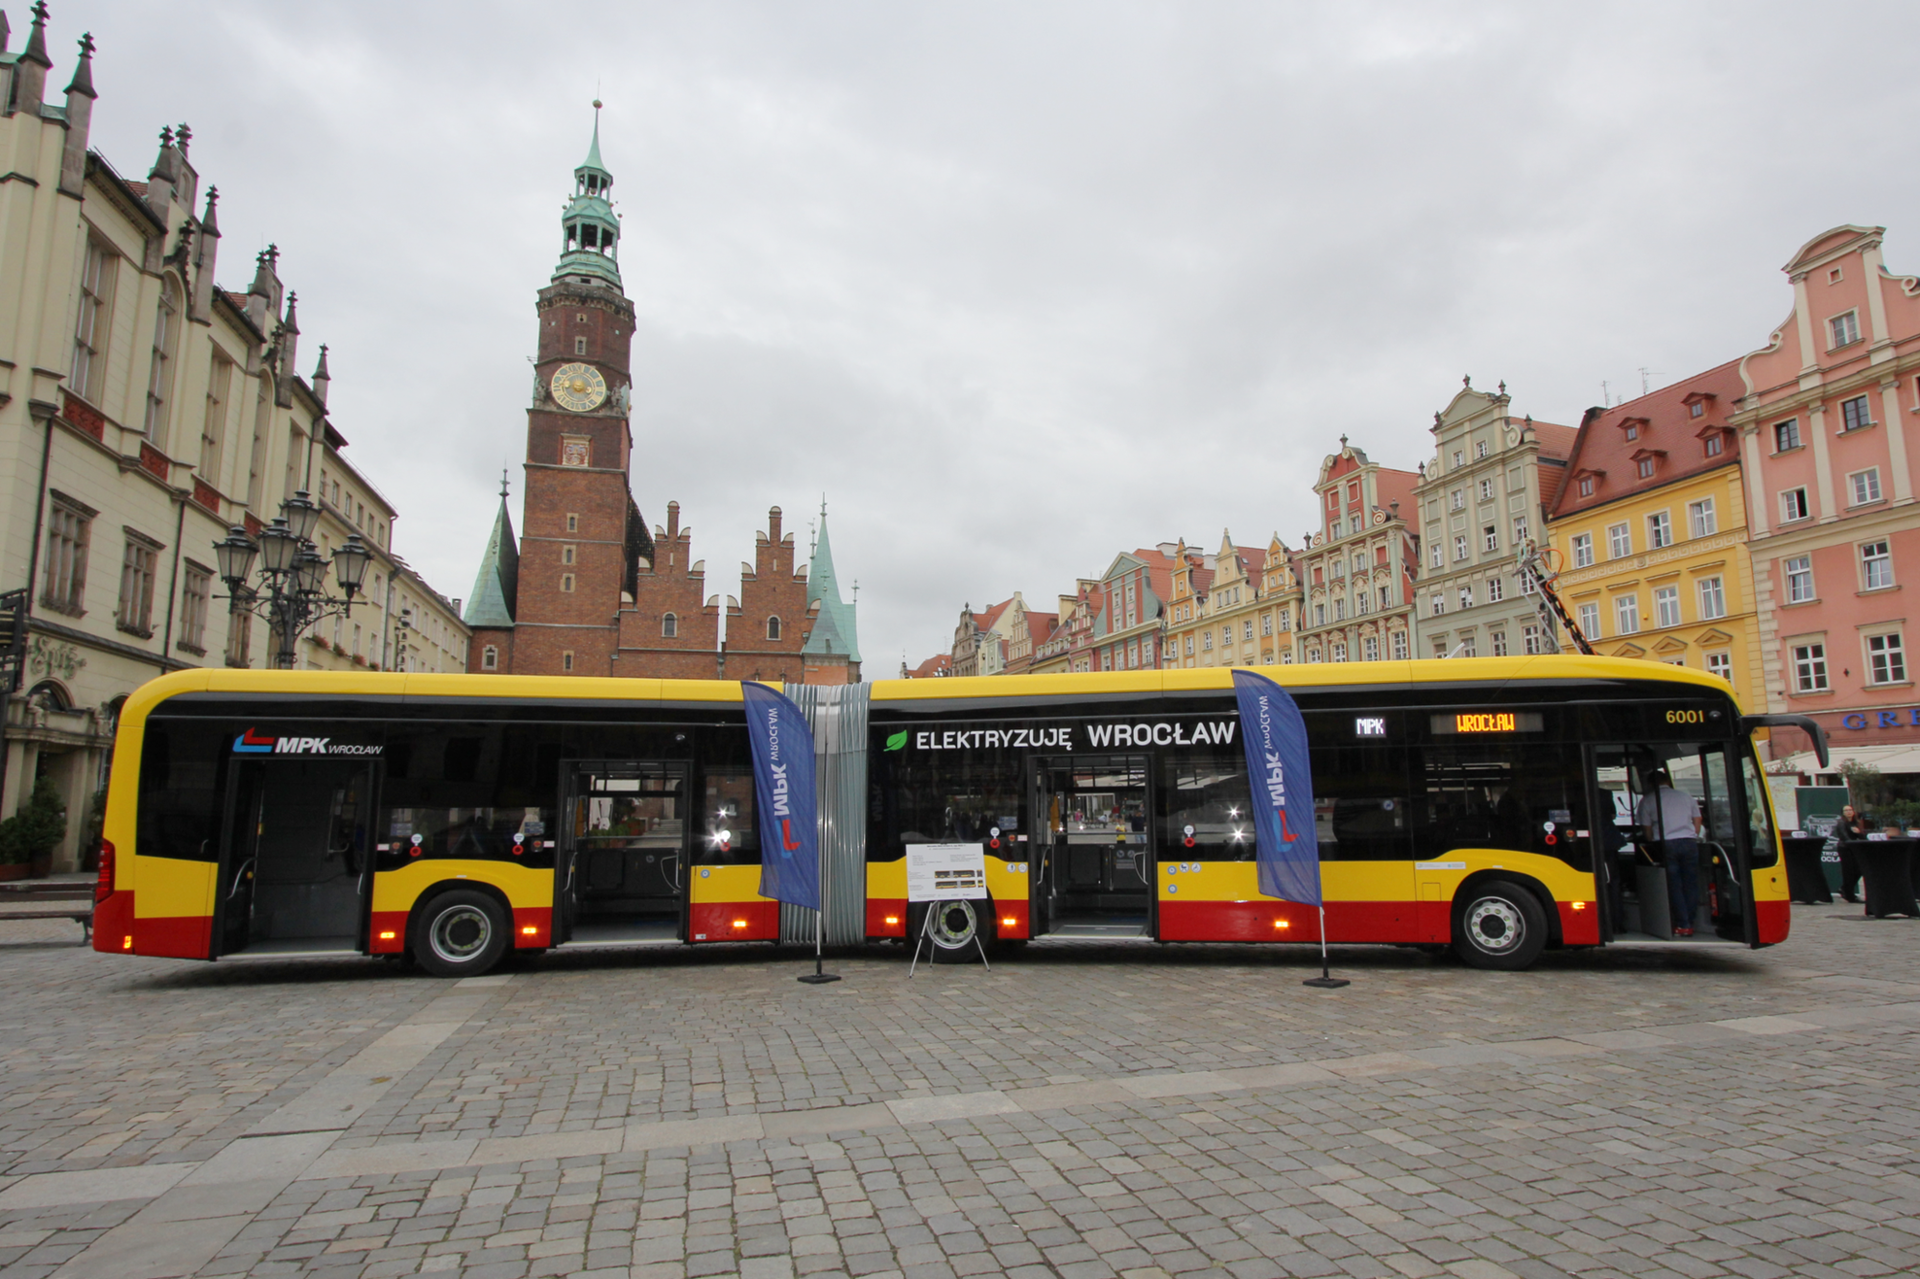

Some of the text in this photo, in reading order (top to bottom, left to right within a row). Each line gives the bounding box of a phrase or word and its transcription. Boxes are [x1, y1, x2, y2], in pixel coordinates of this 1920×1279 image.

[1456, 714, 1515, 732] WROCŁAW
[1666, 710, 1704, 723] 6001
[1356, 718, 1384, 734] MPK
[917, 722, 1235, 750] ELEKTRYZUJĘ WROCŁAW
[275, 737, 383, 755] MPK WROCŁAW
